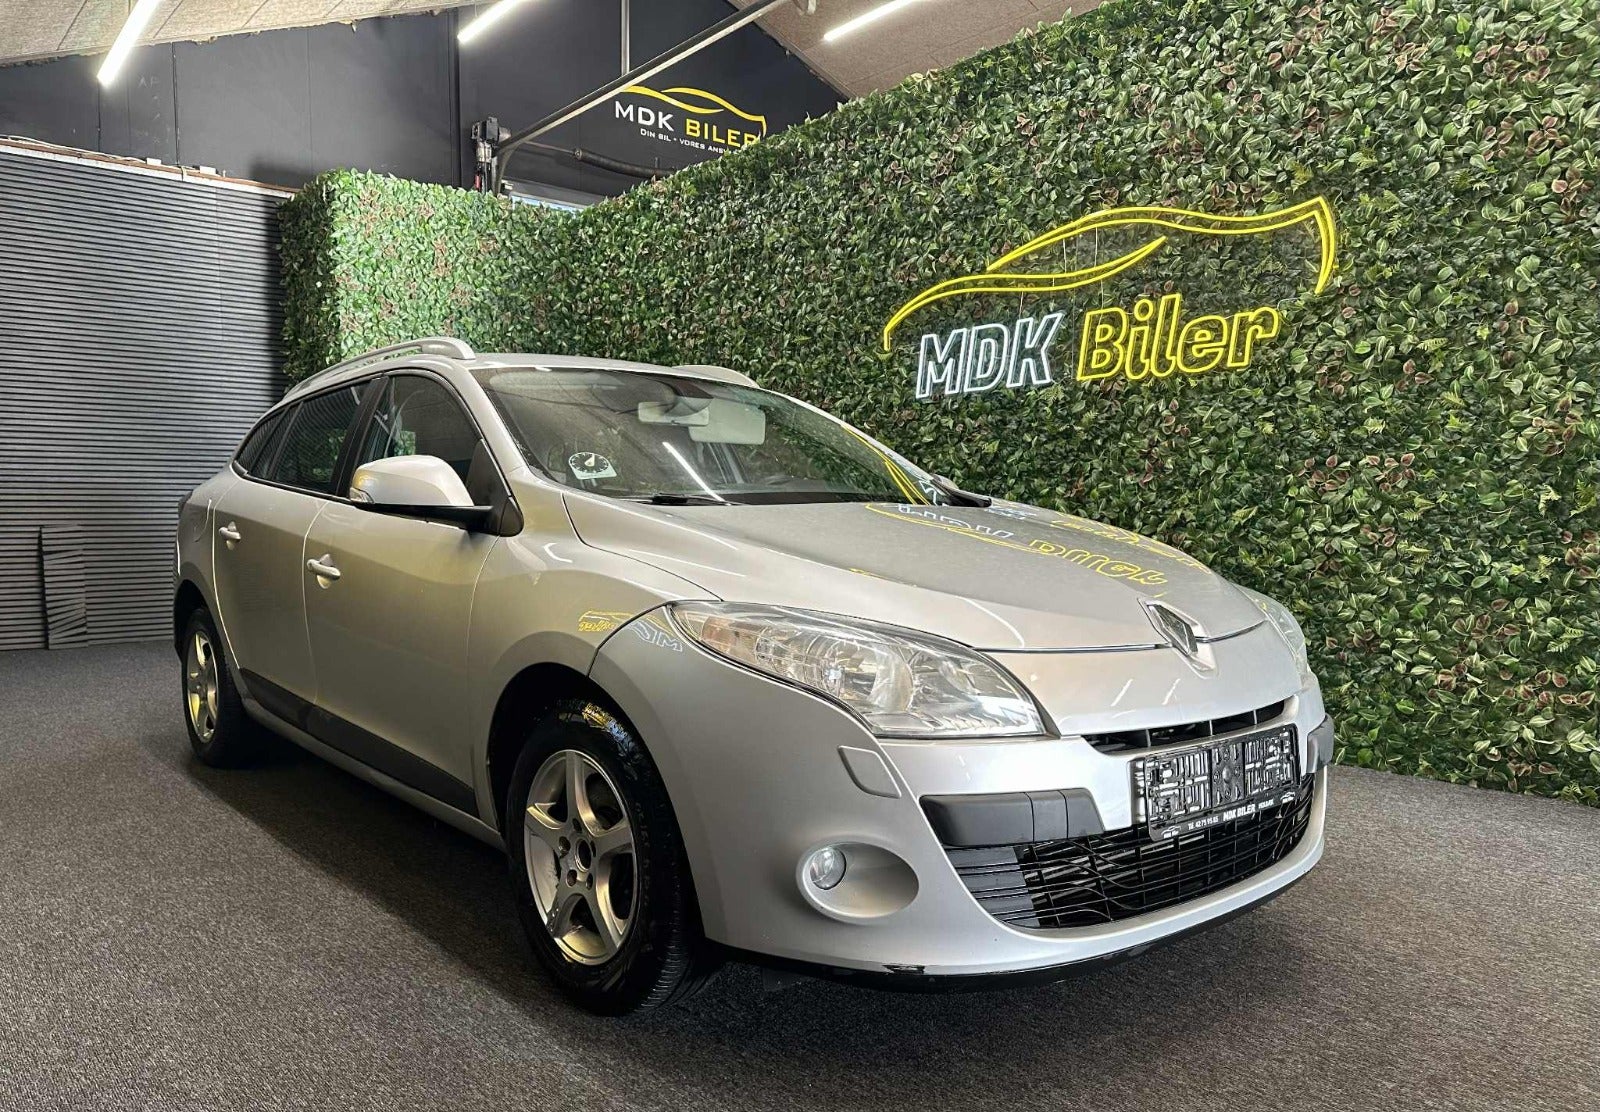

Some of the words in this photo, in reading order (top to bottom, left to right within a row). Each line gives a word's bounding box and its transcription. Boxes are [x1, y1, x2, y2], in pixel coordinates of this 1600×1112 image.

[615, 101, 674, 131] MDK
[915, 312, 1064, 399] MDK
[1077, 293, 1279, 381] Biler
[1223, 808, 1236, 822] MDK
[1237, 803, 1256, 818] BILER
